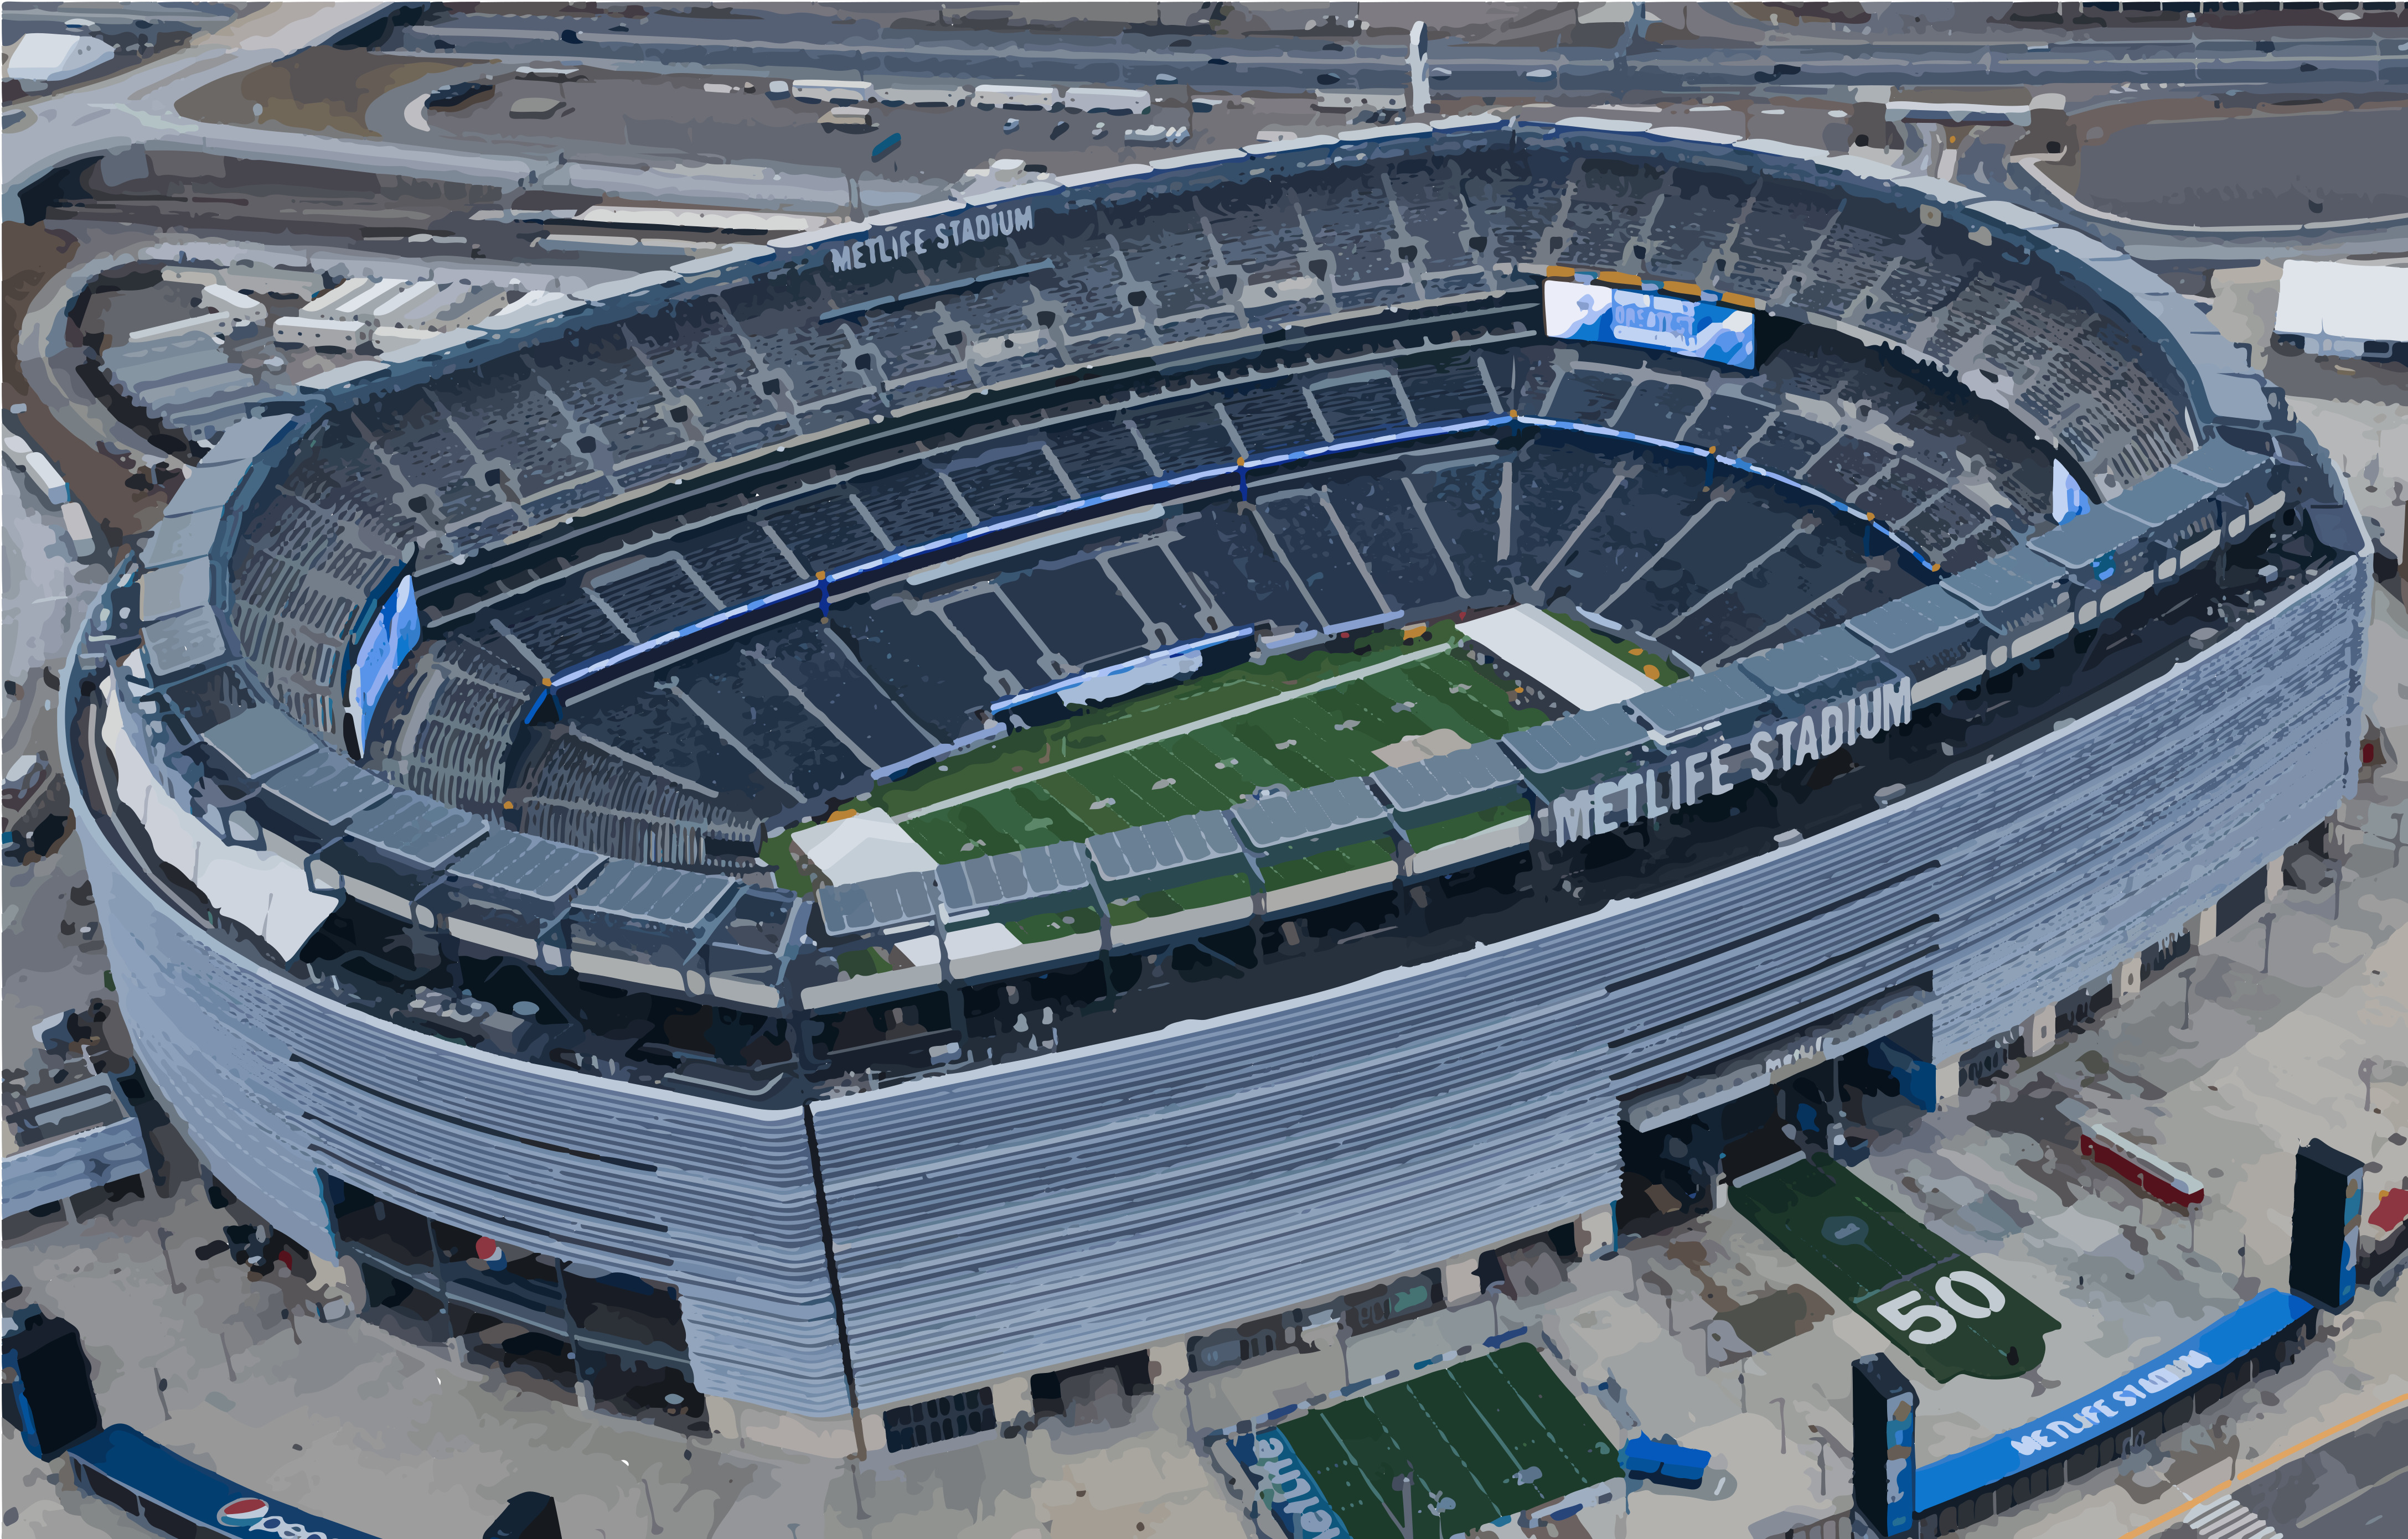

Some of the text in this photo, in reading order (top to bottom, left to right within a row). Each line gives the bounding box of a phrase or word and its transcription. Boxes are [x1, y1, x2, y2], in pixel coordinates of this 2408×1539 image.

[830, 205, 1035, 273] METLIFE STADIUM
[1553, 676, 1911, 847] METLIFE STADIUM
[1877, 1271, 2006, 1345] 50
